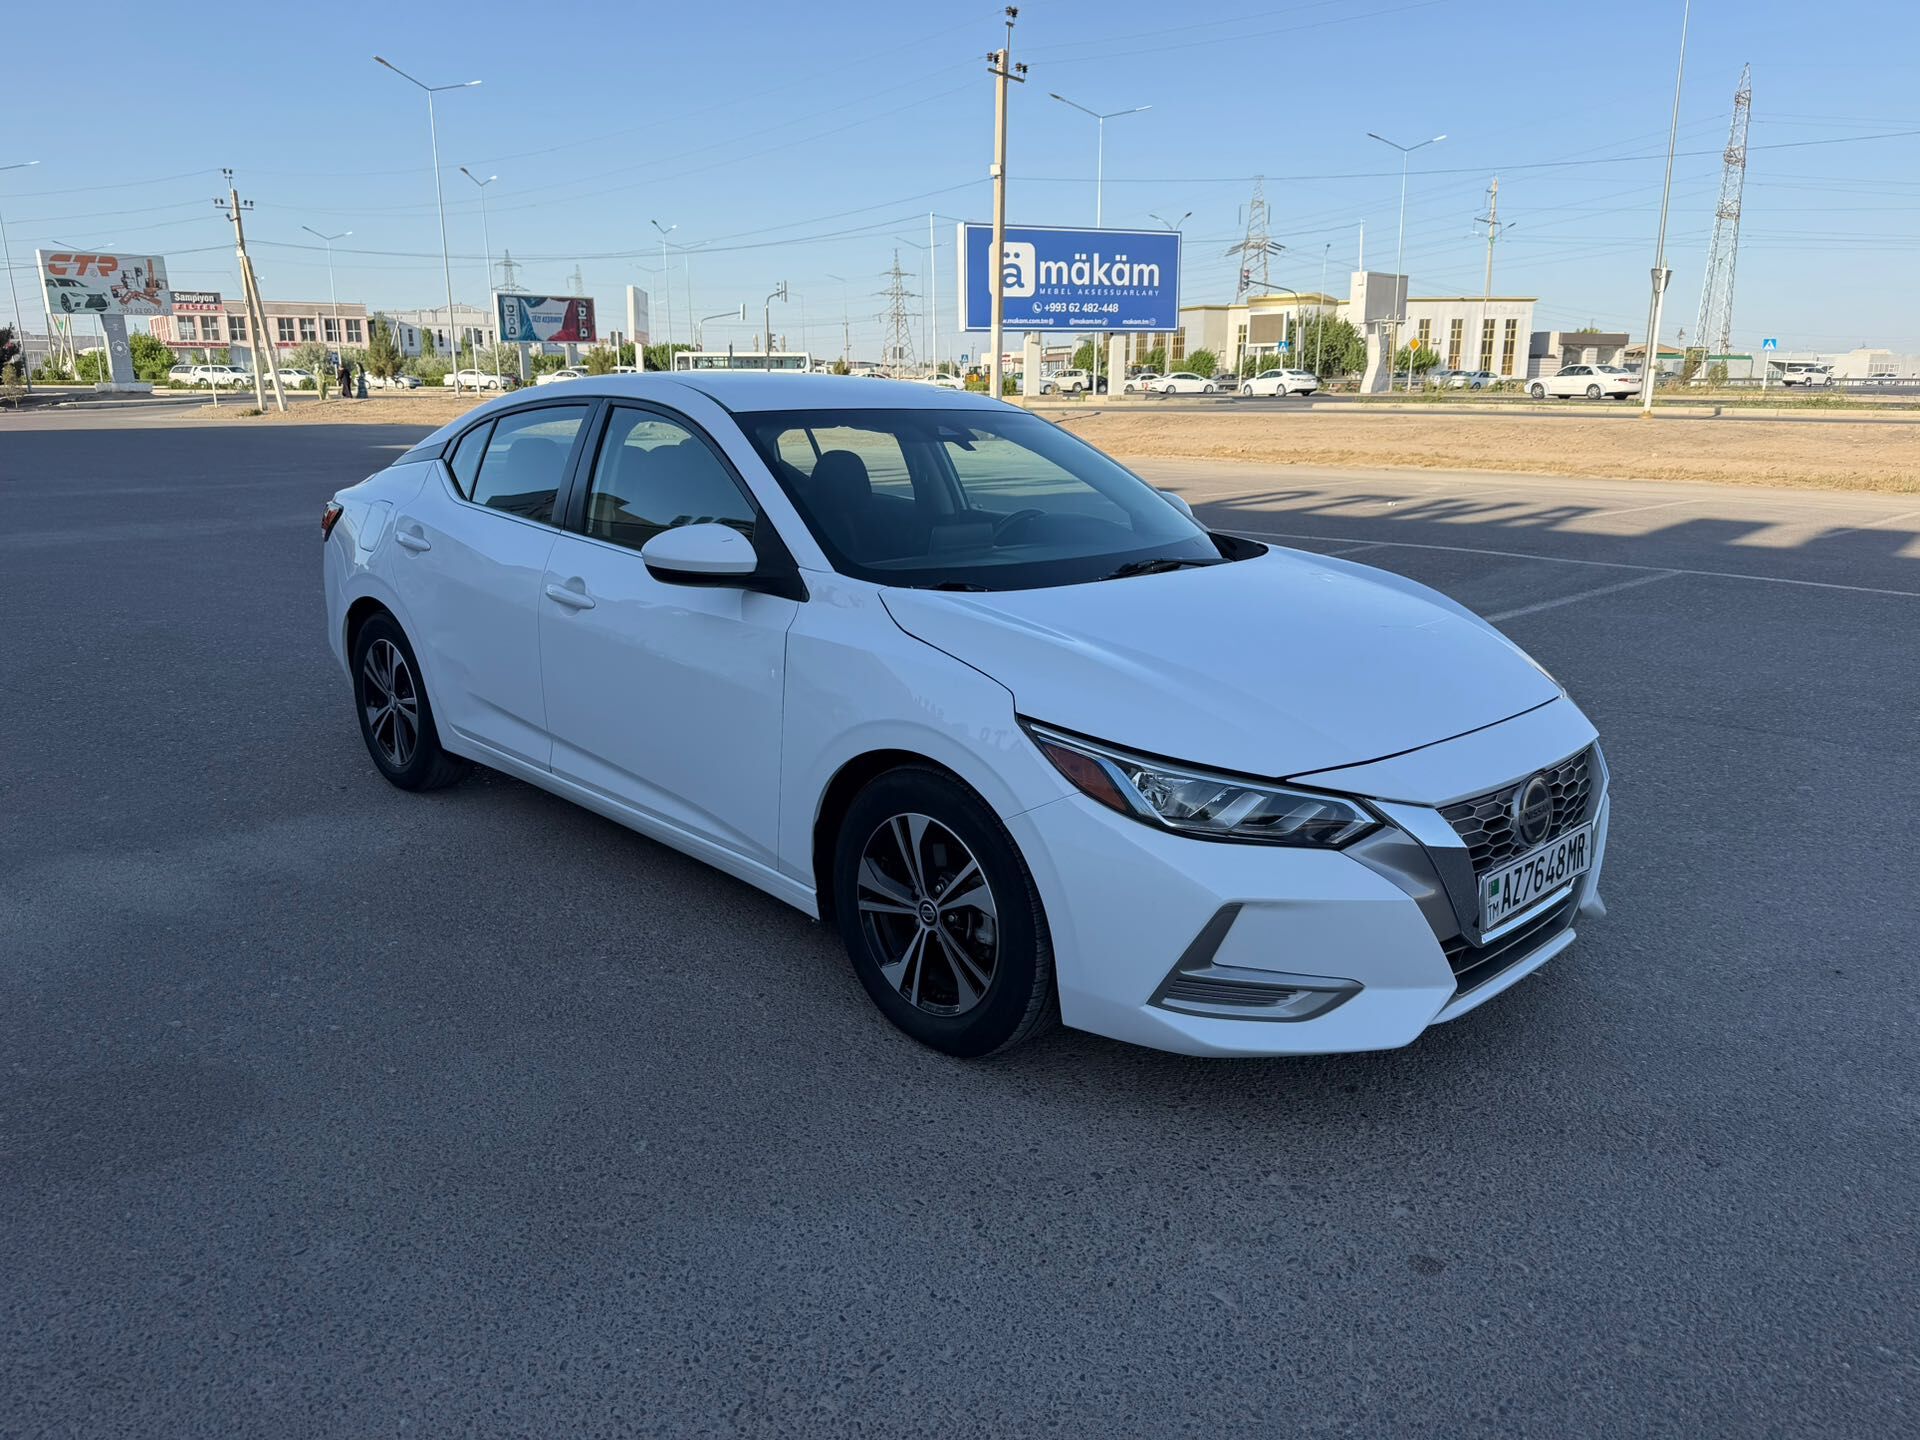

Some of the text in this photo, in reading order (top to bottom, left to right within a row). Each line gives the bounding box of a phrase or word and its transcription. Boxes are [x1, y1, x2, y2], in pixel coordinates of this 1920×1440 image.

[48, 253, 118, 277] CTR
[1039, 253, 1160, 287] mäkäm
[1039, 287, 1160, 297] MEBEL AKSESSUARLARY
[505, 304, 517, 335] bold
[1043, 302, 1119, 313] +993 62 482-448
[1501, 832, 1586, 914] AZ7648MR
[1488, 901, 1499, 922] TM
